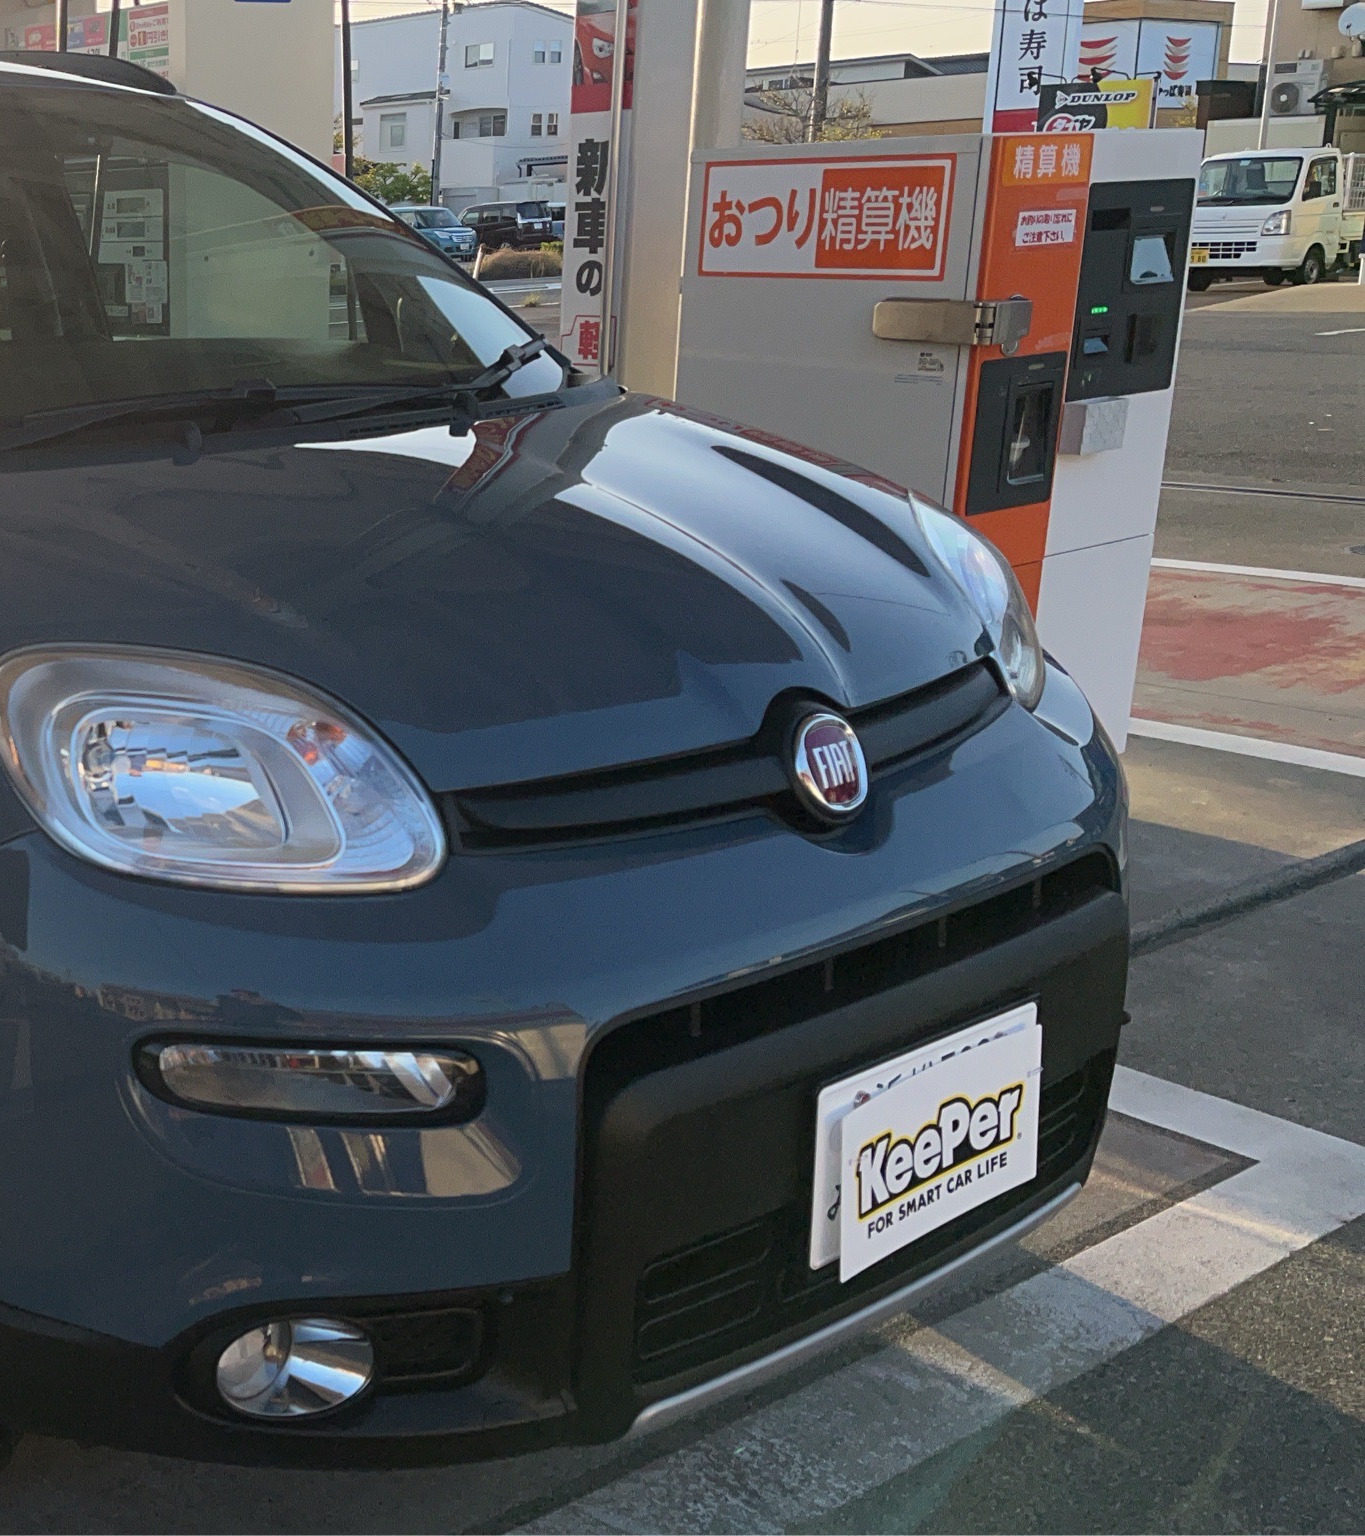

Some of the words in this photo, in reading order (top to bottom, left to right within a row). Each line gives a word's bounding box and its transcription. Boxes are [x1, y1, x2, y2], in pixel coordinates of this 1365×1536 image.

[1069, 92, 1137, 103] DUNLOP
[1013, 143, 1081, 179] 精算機
[573, 138, 610, 297] 新車の
[708, 185, 938, 253] おつり精算機
[812, 740, 856, 789] FIAT
[857, 1083, 1024, 1221] KeePer
[867, 1211, 894, 1239] FOR
[898, 1184, 943, 1221] SMART
[946, 1169, 973, 1194] CAR
[977, 1151, 1008, 1179] LIFE
